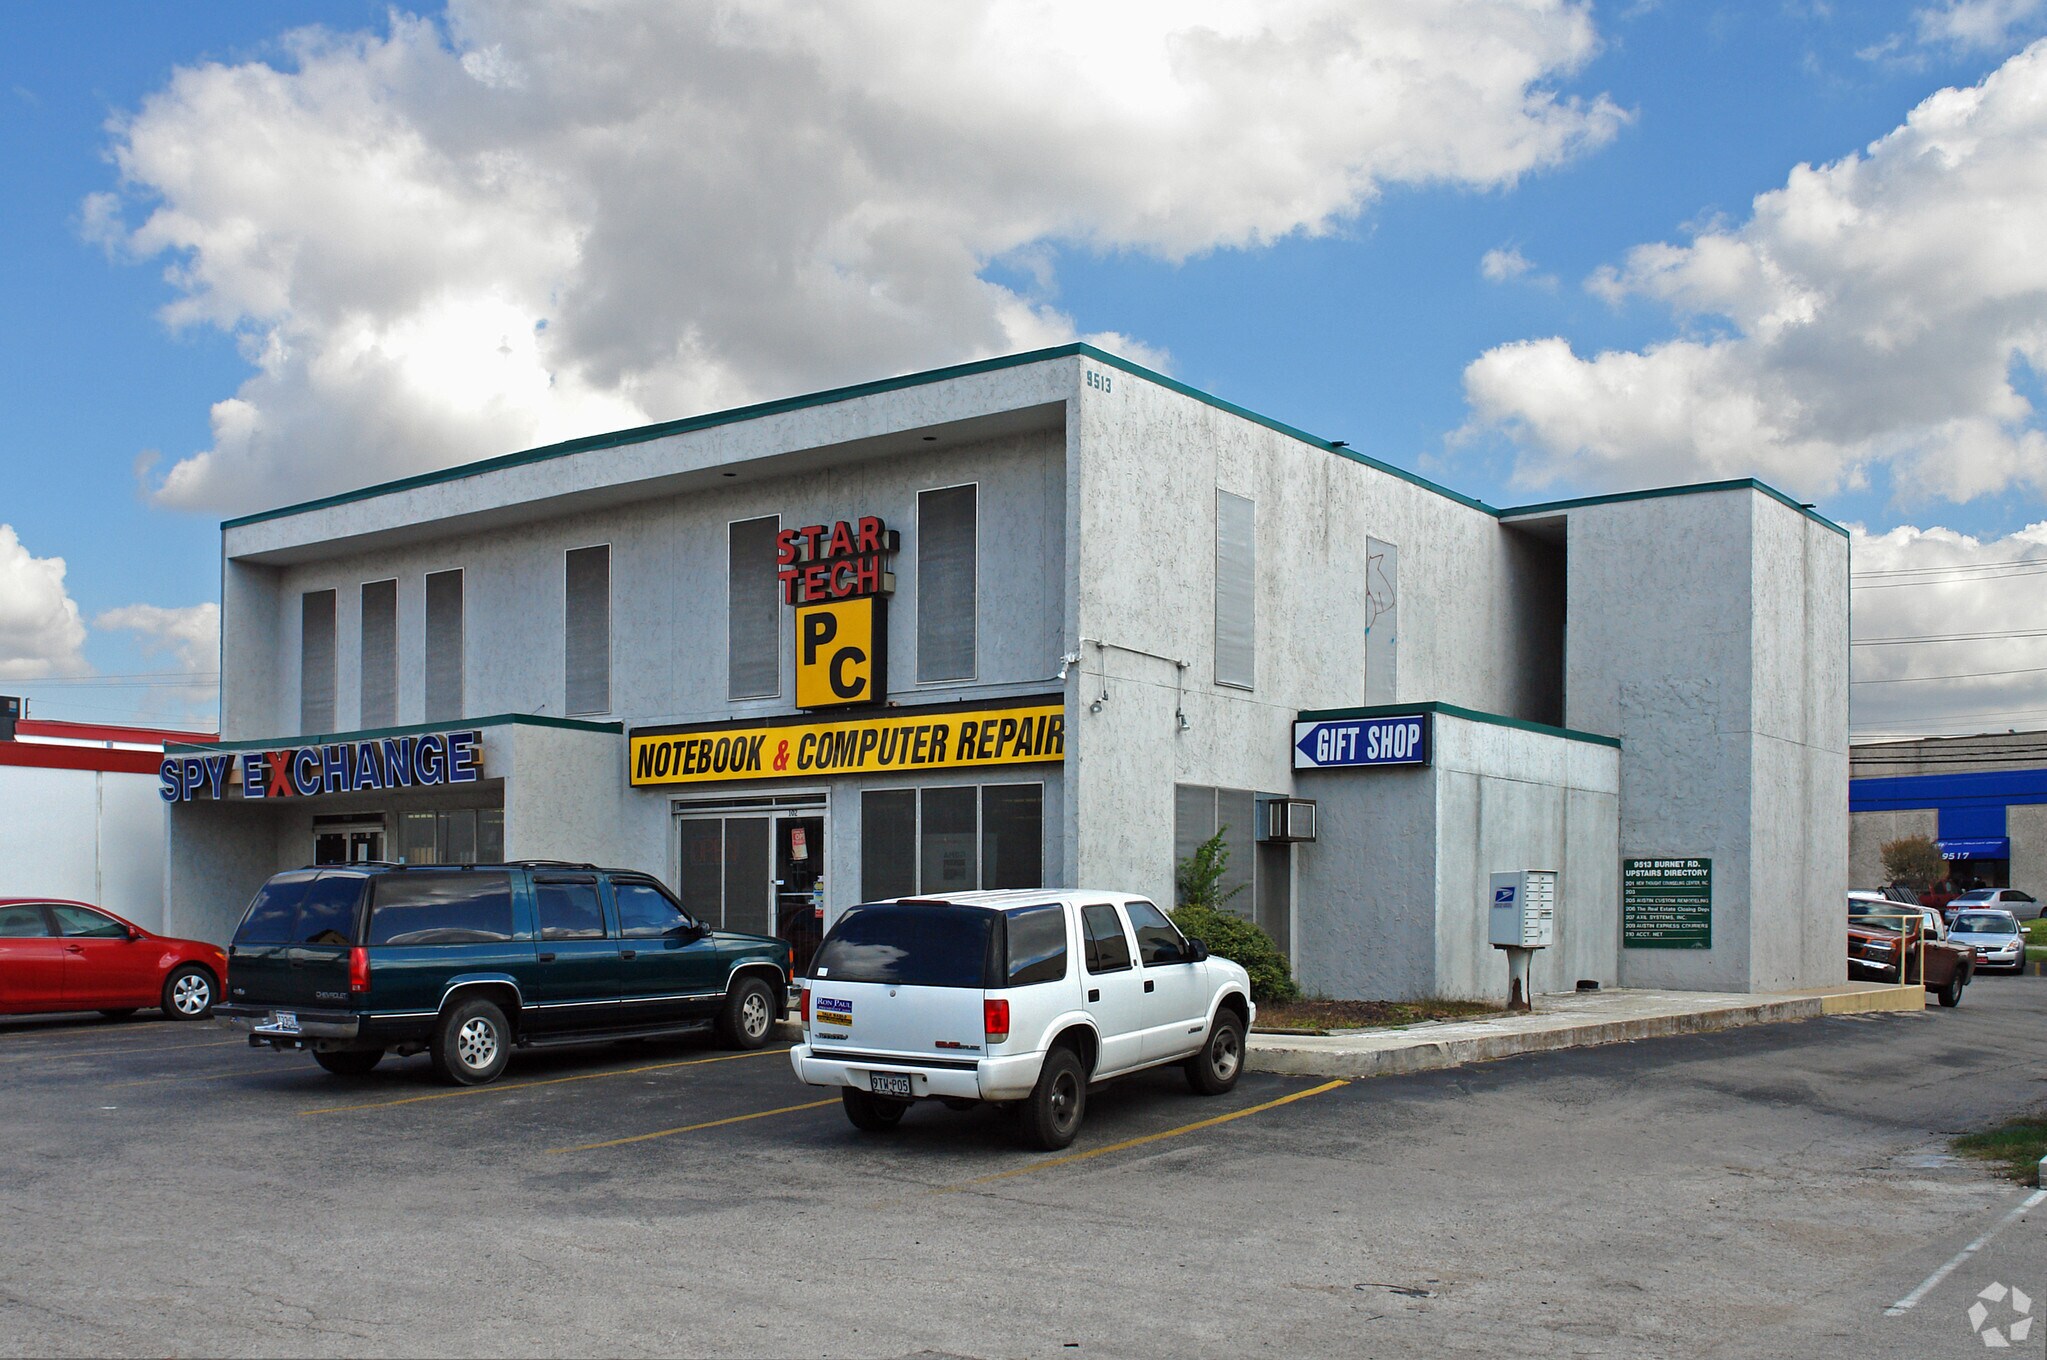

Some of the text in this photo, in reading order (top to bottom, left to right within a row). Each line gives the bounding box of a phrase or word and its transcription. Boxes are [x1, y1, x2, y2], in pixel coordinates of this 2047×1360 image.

[1086, 370, 1111, 394] 9513
[776, 516, 882, 565] STAR
[778, 555, 880, 605] TECH
[636, 714, 1064, 778] NOTEBOOK & COMPUTER REPAIR
[1316, 724, 1420, 762] GIFT SHOP
[158, 731, 480, 803] SPY EXCHANGE
[1654, 860, 1685, 868] BURNET
[1687, 860, 1701, 868] RD.
[1941, 852, 1970, 860] 9517
[1625, 869, 1708, 877] UPSTAIRS DIRECTORY
[834, 999, 851, 1008] PAUL
